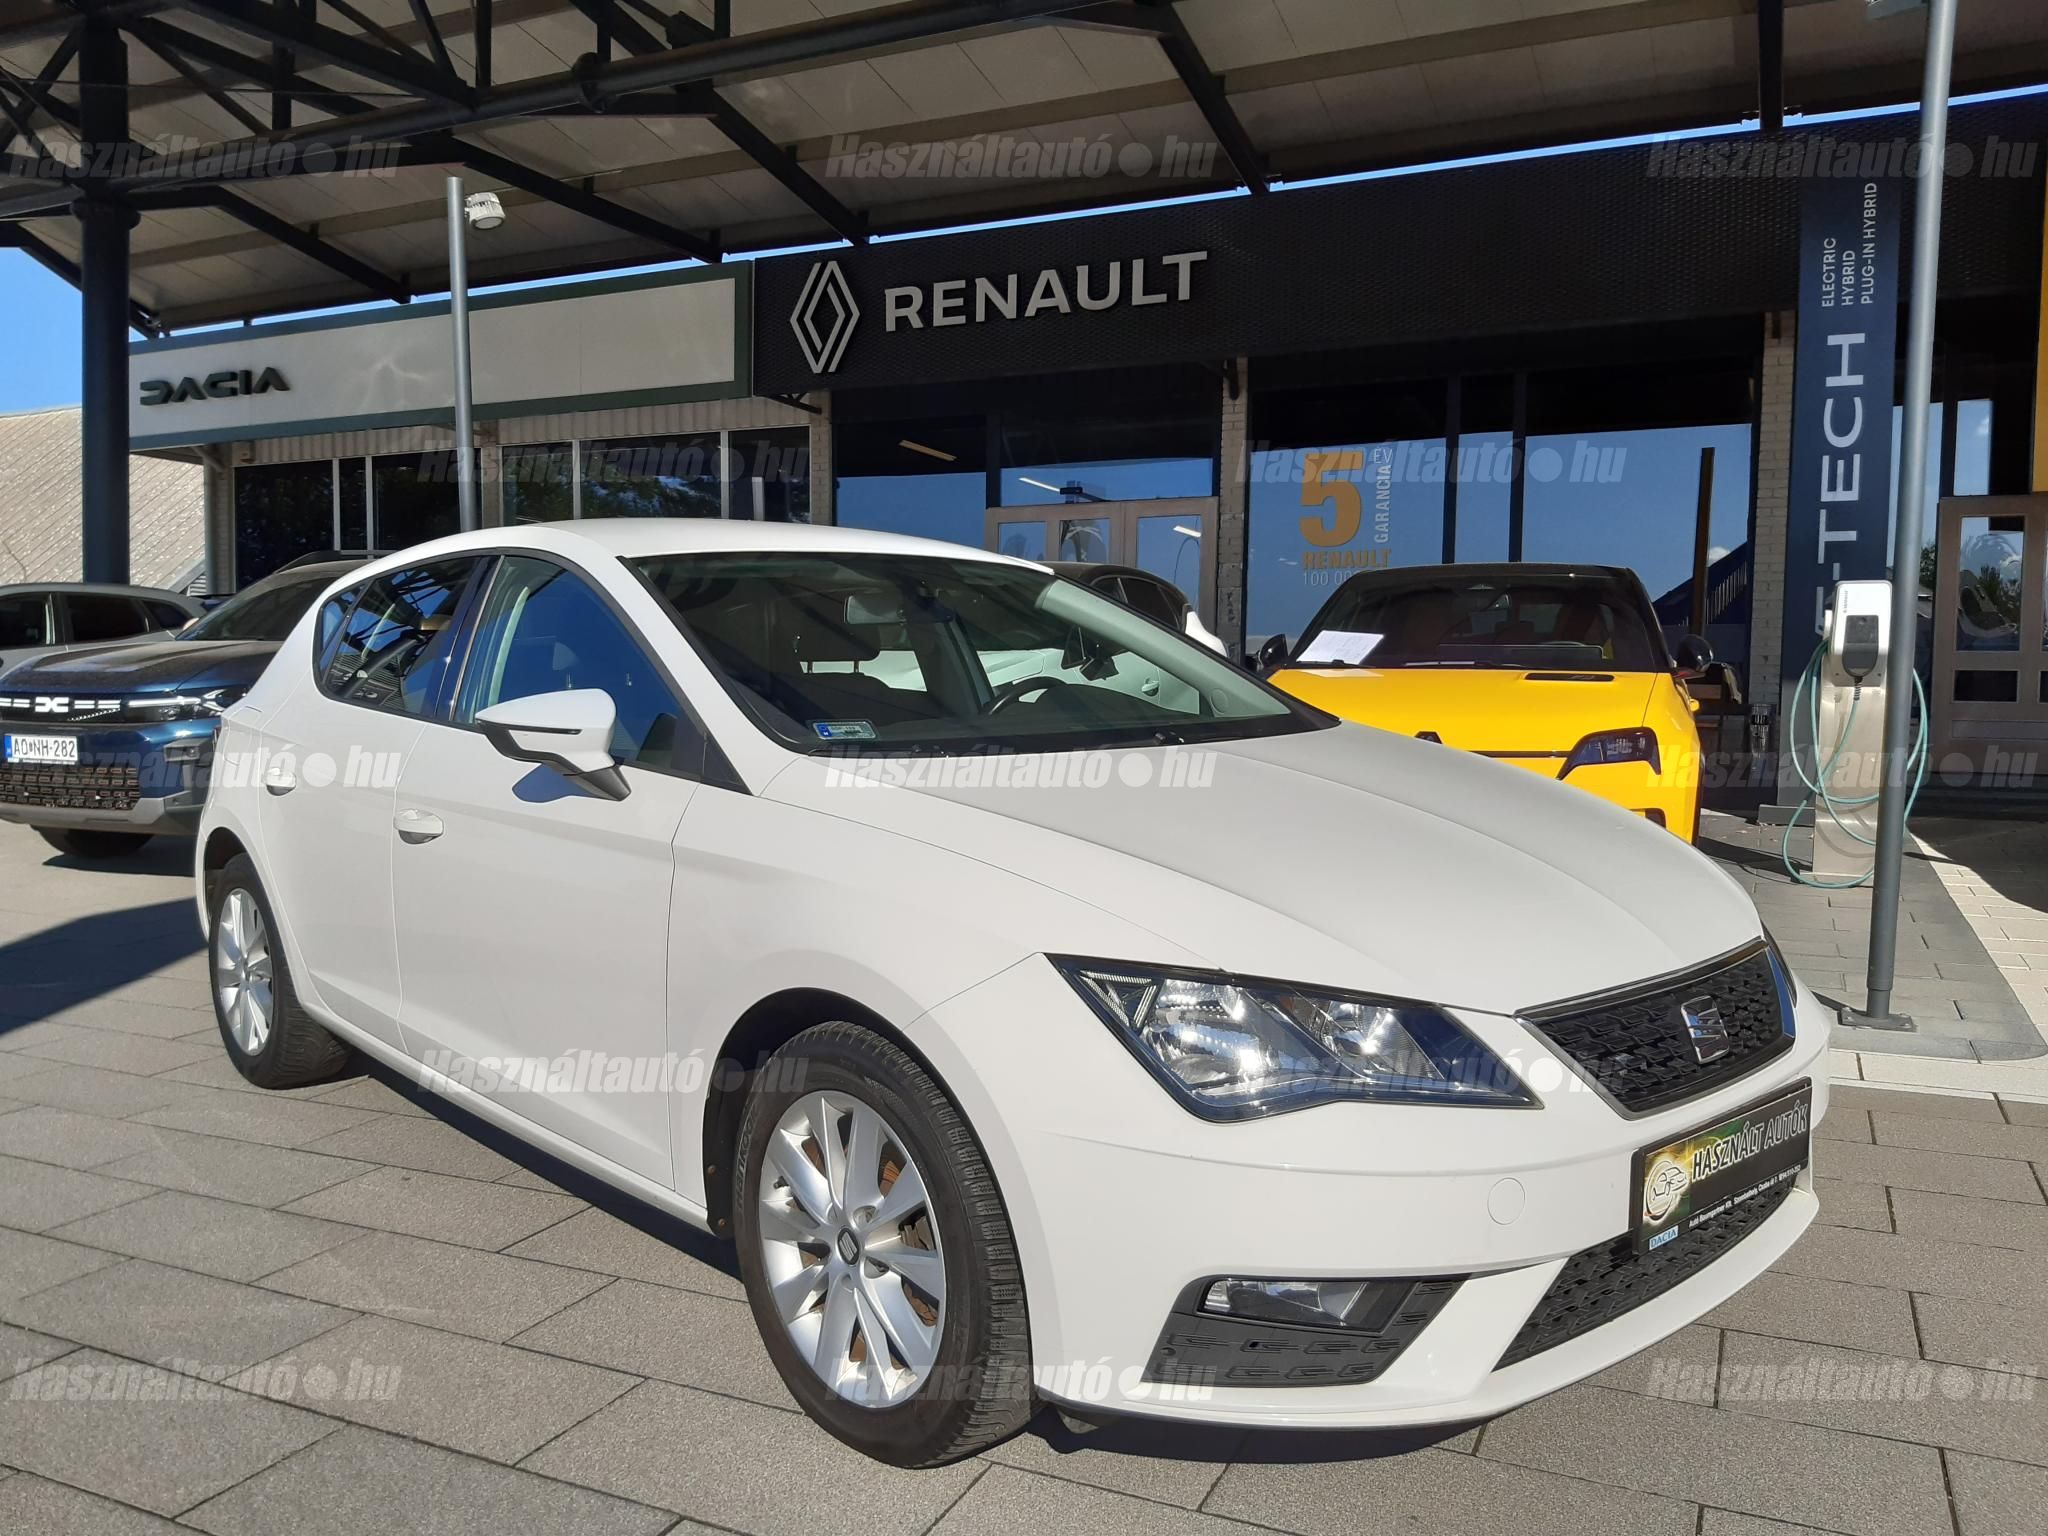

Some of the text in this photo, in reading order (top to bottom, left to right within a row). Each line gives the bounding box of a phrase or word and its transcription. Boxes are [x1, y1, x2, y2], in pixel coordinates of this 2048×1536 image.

[1821, 237, 1836, 307] ELECTRIC
[1841, 249, 1856, 306] HYBRID
[1860, 182, 1878, 304] PLUG-IN HYBRID
[884, 250, 1208, 332] RENAULT
[139, 366, 291, 406] DACIA
[1299, 450, 1363, 548] 5
[1374, 464, 1393, 544] GARANCIA
[1303, 549, 1393, 570] RENAULT
[1303, 570, 1330, 586] 100
[1691, 1099, 1809, 1184] HASZNÁLT AUTÓK
[1650, 1227, 1678, 1249] DACIA
